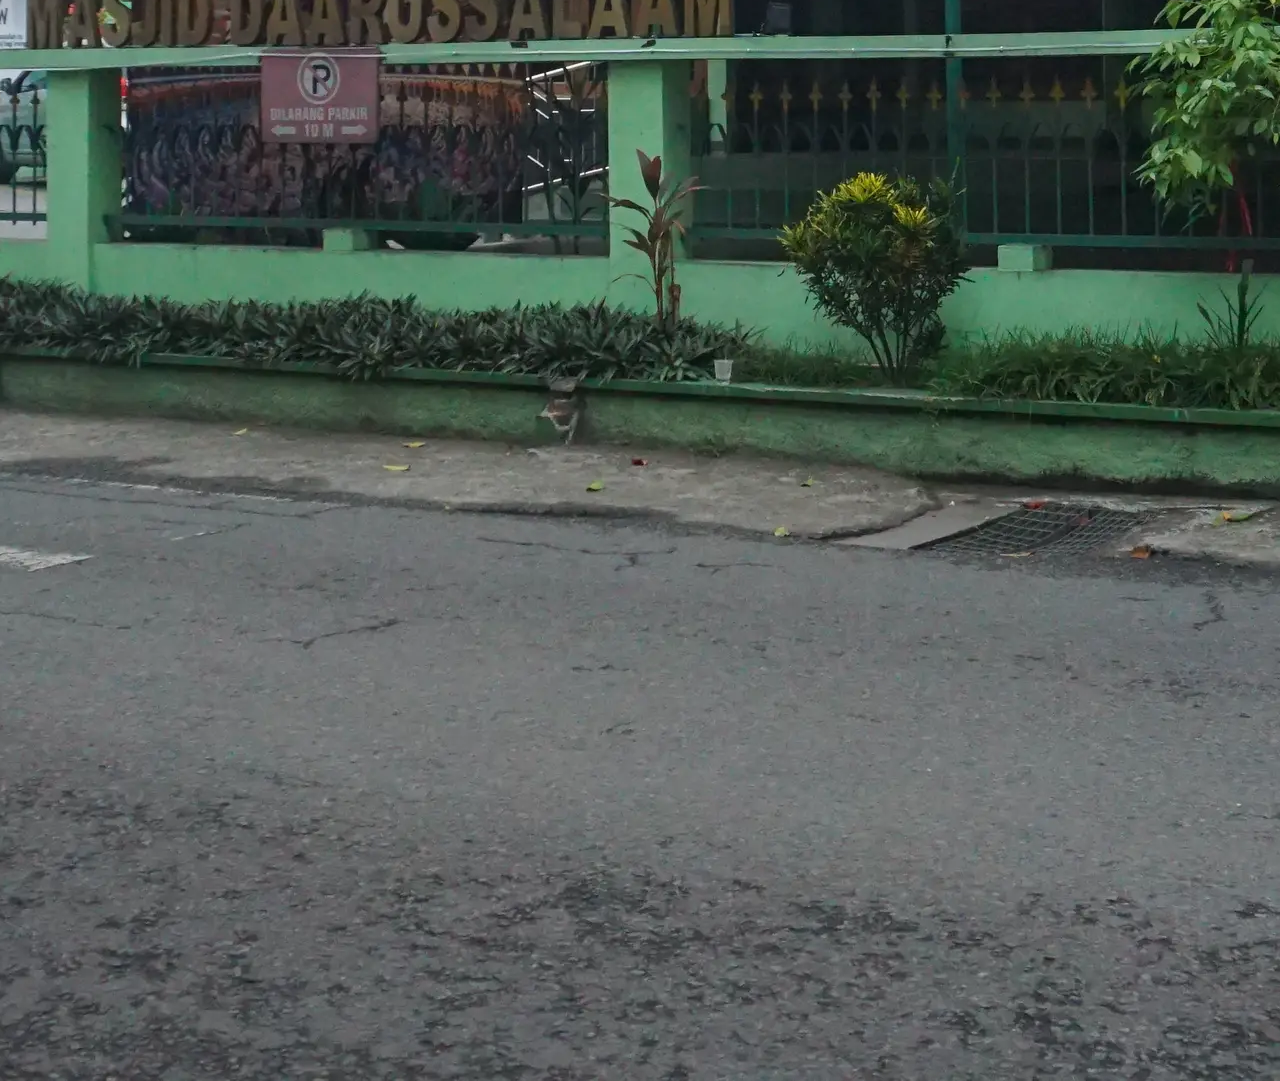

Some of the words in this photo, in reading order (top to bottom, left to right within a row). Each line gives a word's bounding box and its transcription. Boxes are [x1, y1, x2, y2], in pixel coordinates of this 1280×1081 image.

[270, 107, 324, 121] DILARANG
[328, 107, 368, 121] PARKIR
[304, 123, 319, 137] 10
[322, 123, 334, 137] M
